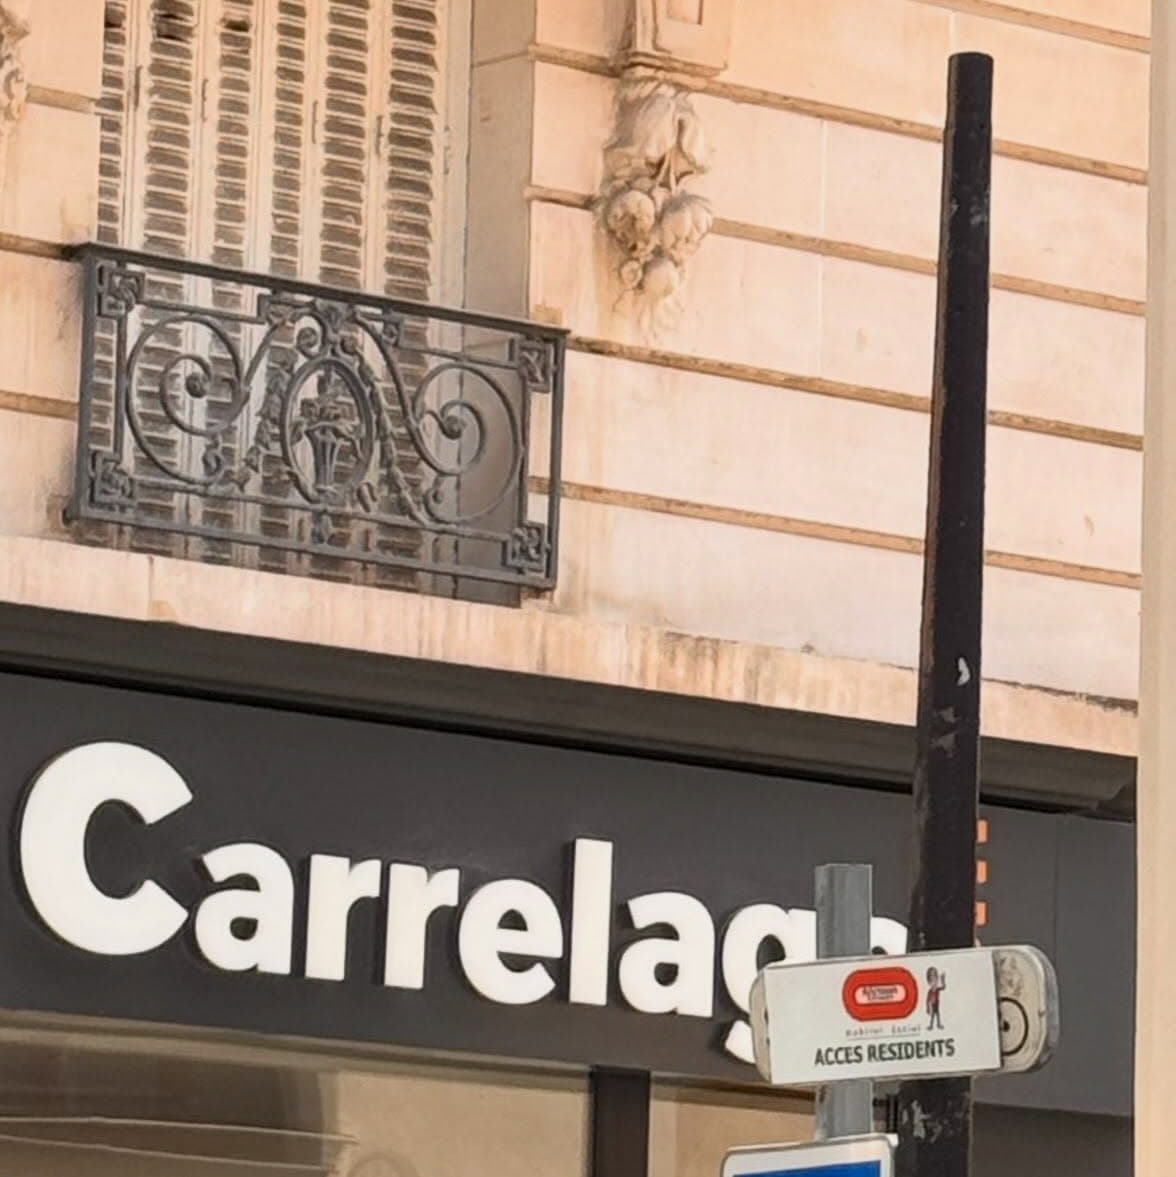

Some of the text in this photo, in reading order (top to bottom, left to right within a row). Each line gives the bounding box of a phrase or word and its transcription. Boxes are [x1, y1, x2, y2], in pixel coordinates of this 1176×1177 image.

[20, 741, 909, 1065] Carrelag
[814, 1038, 955, 1066] ACCES RESIDENTS
